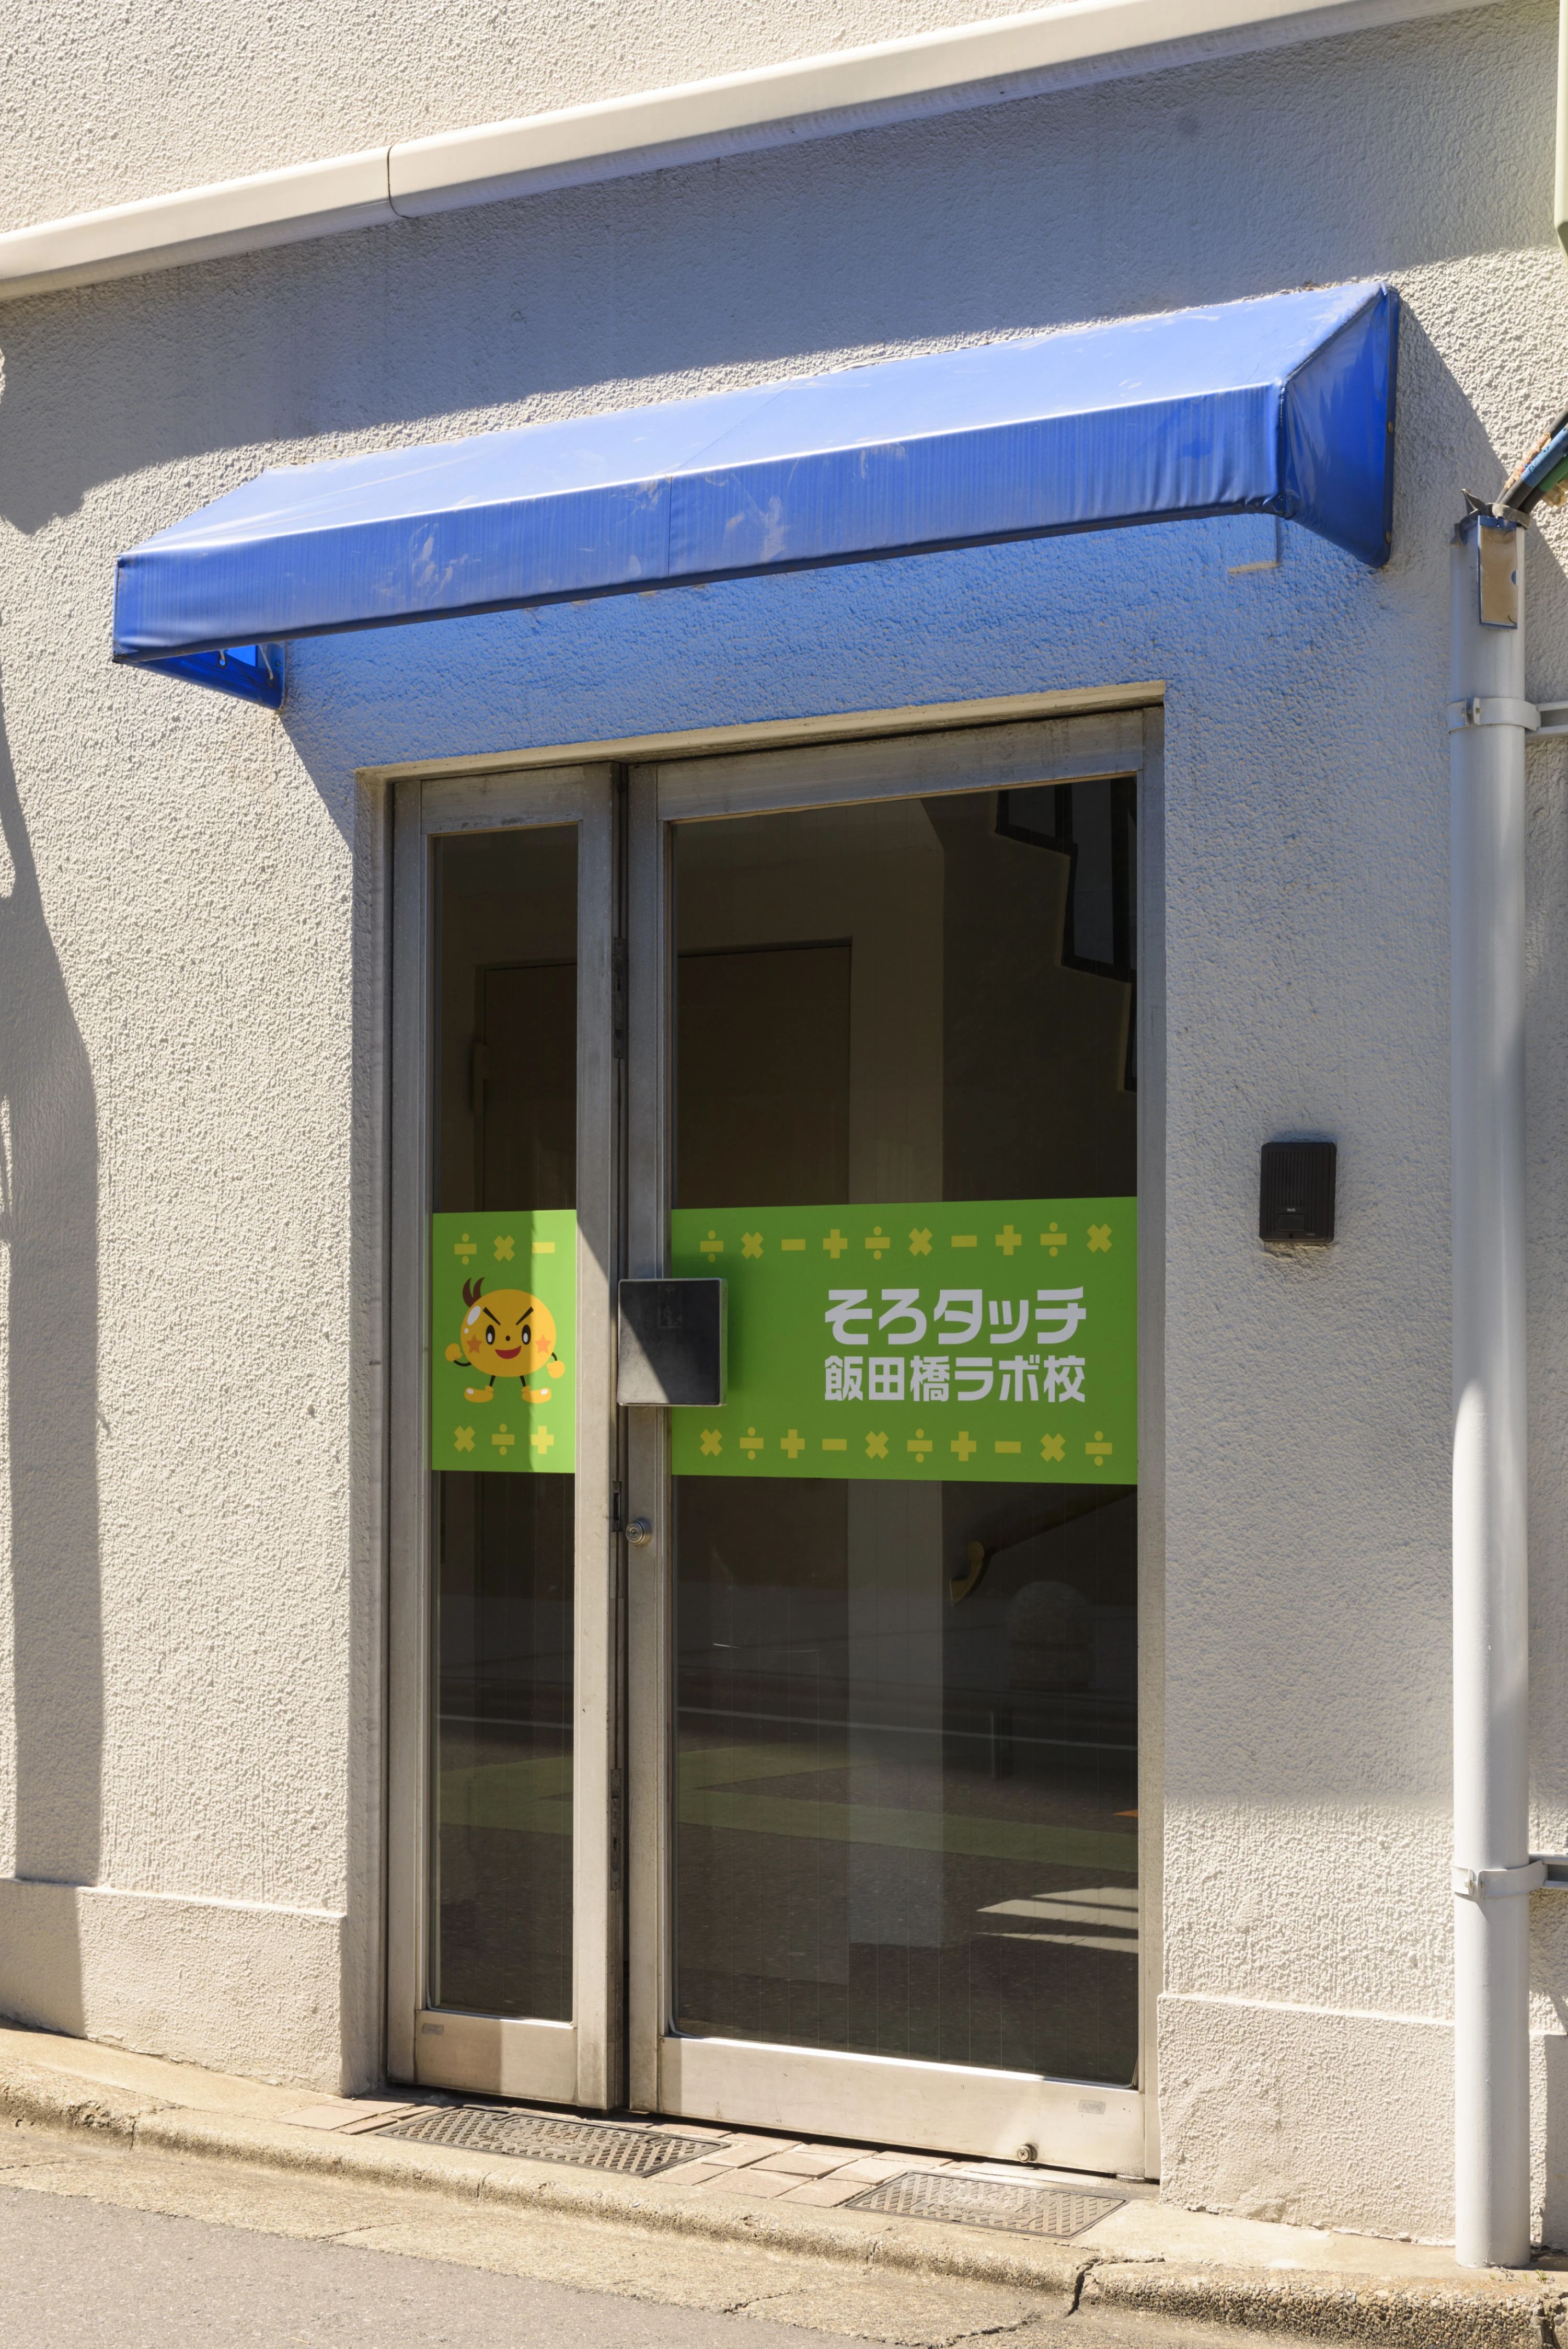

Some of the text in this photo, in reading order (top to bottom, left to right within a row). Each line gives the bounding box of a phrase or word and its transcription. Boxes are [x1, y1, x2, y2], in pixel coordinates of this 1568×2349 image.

[825, 1286, 1086, 1344] そろタッチ
[824, 1354, 1086, 1402] 飯田橋ラボ校
